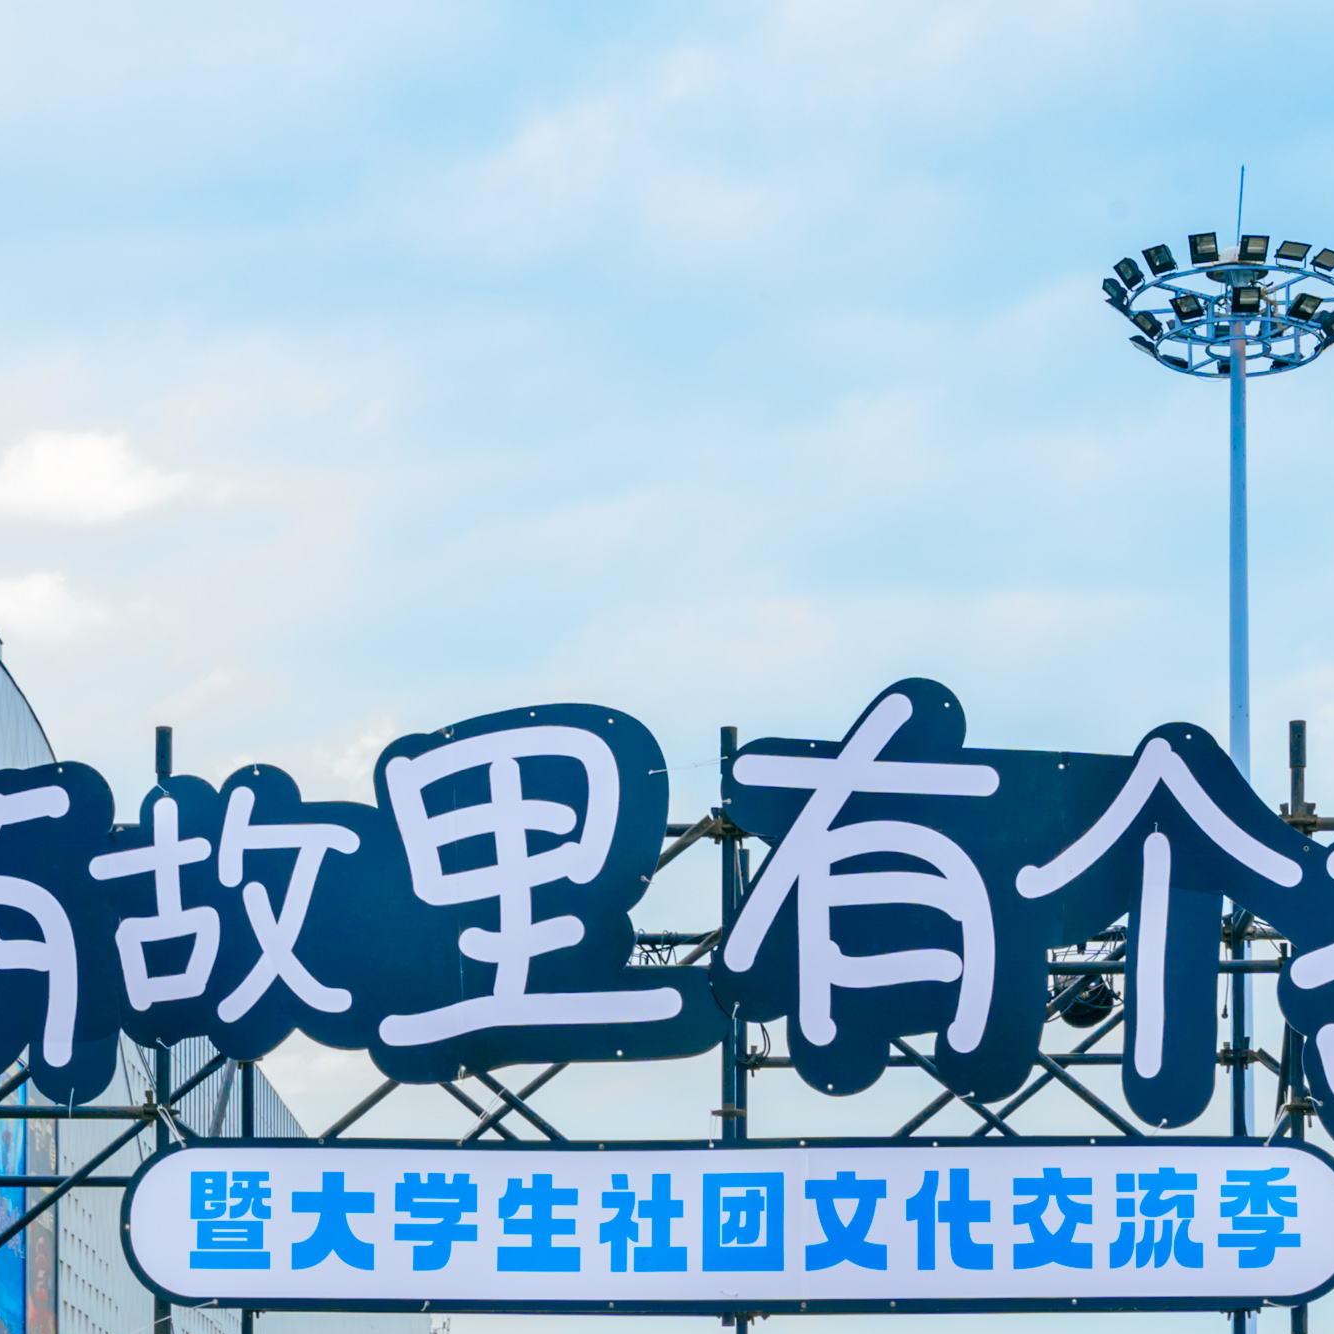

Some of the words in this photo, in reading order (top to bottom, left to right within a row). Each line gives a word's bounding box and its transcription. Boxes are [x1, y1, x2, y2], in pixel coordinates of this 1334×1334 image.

[189, 1166, 1303, 1272] 暨大学生社团文化交流季
